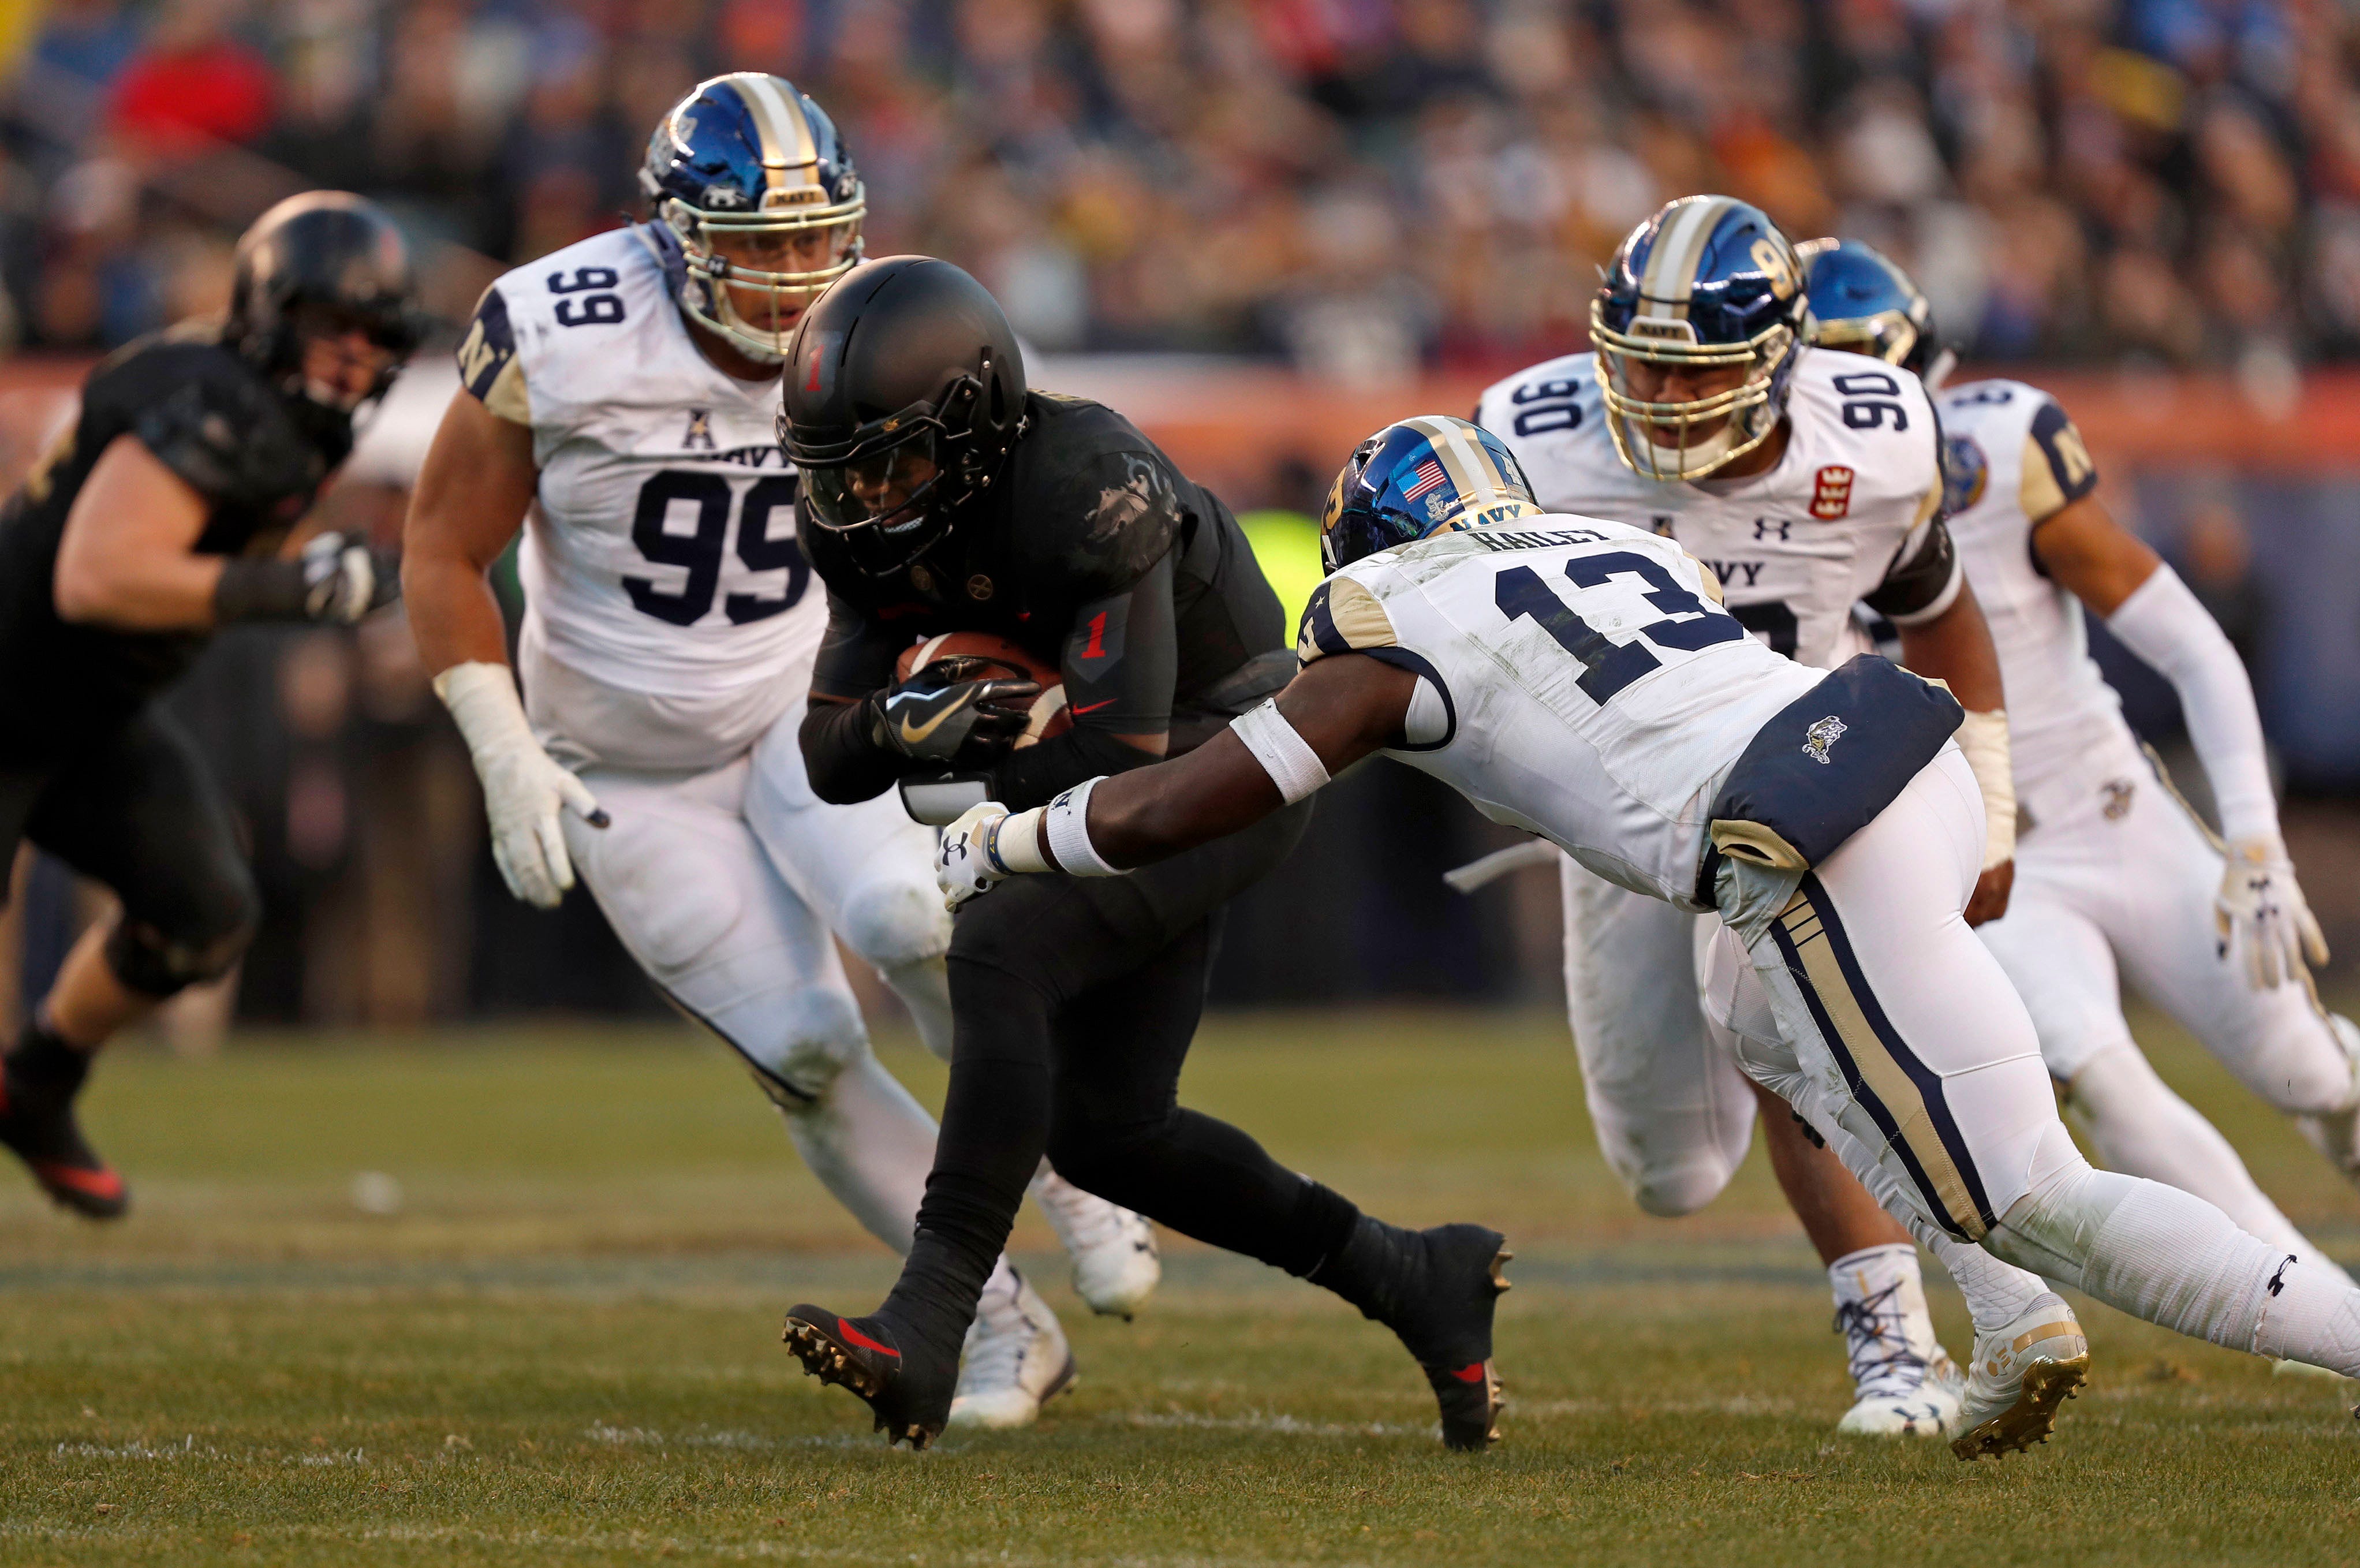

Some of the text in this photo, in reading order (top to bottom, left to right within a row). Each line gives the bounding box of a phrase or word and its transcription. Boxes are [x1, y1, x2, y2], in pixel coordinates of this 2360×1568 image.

[547, 268, 625, 327] 99
[457, 318, 495, 387] N
[806, 344, 824, 391] 1
[1513, 379, 1582, 436] 90
[1832, 372, 1908, 431] 90
[621, 469, 810, 627] 99
[1468, 529, 1611, 551] HAILEY
[1081, 611, 1107, 659] 1
[1495, 551, 1744, 707] 13
